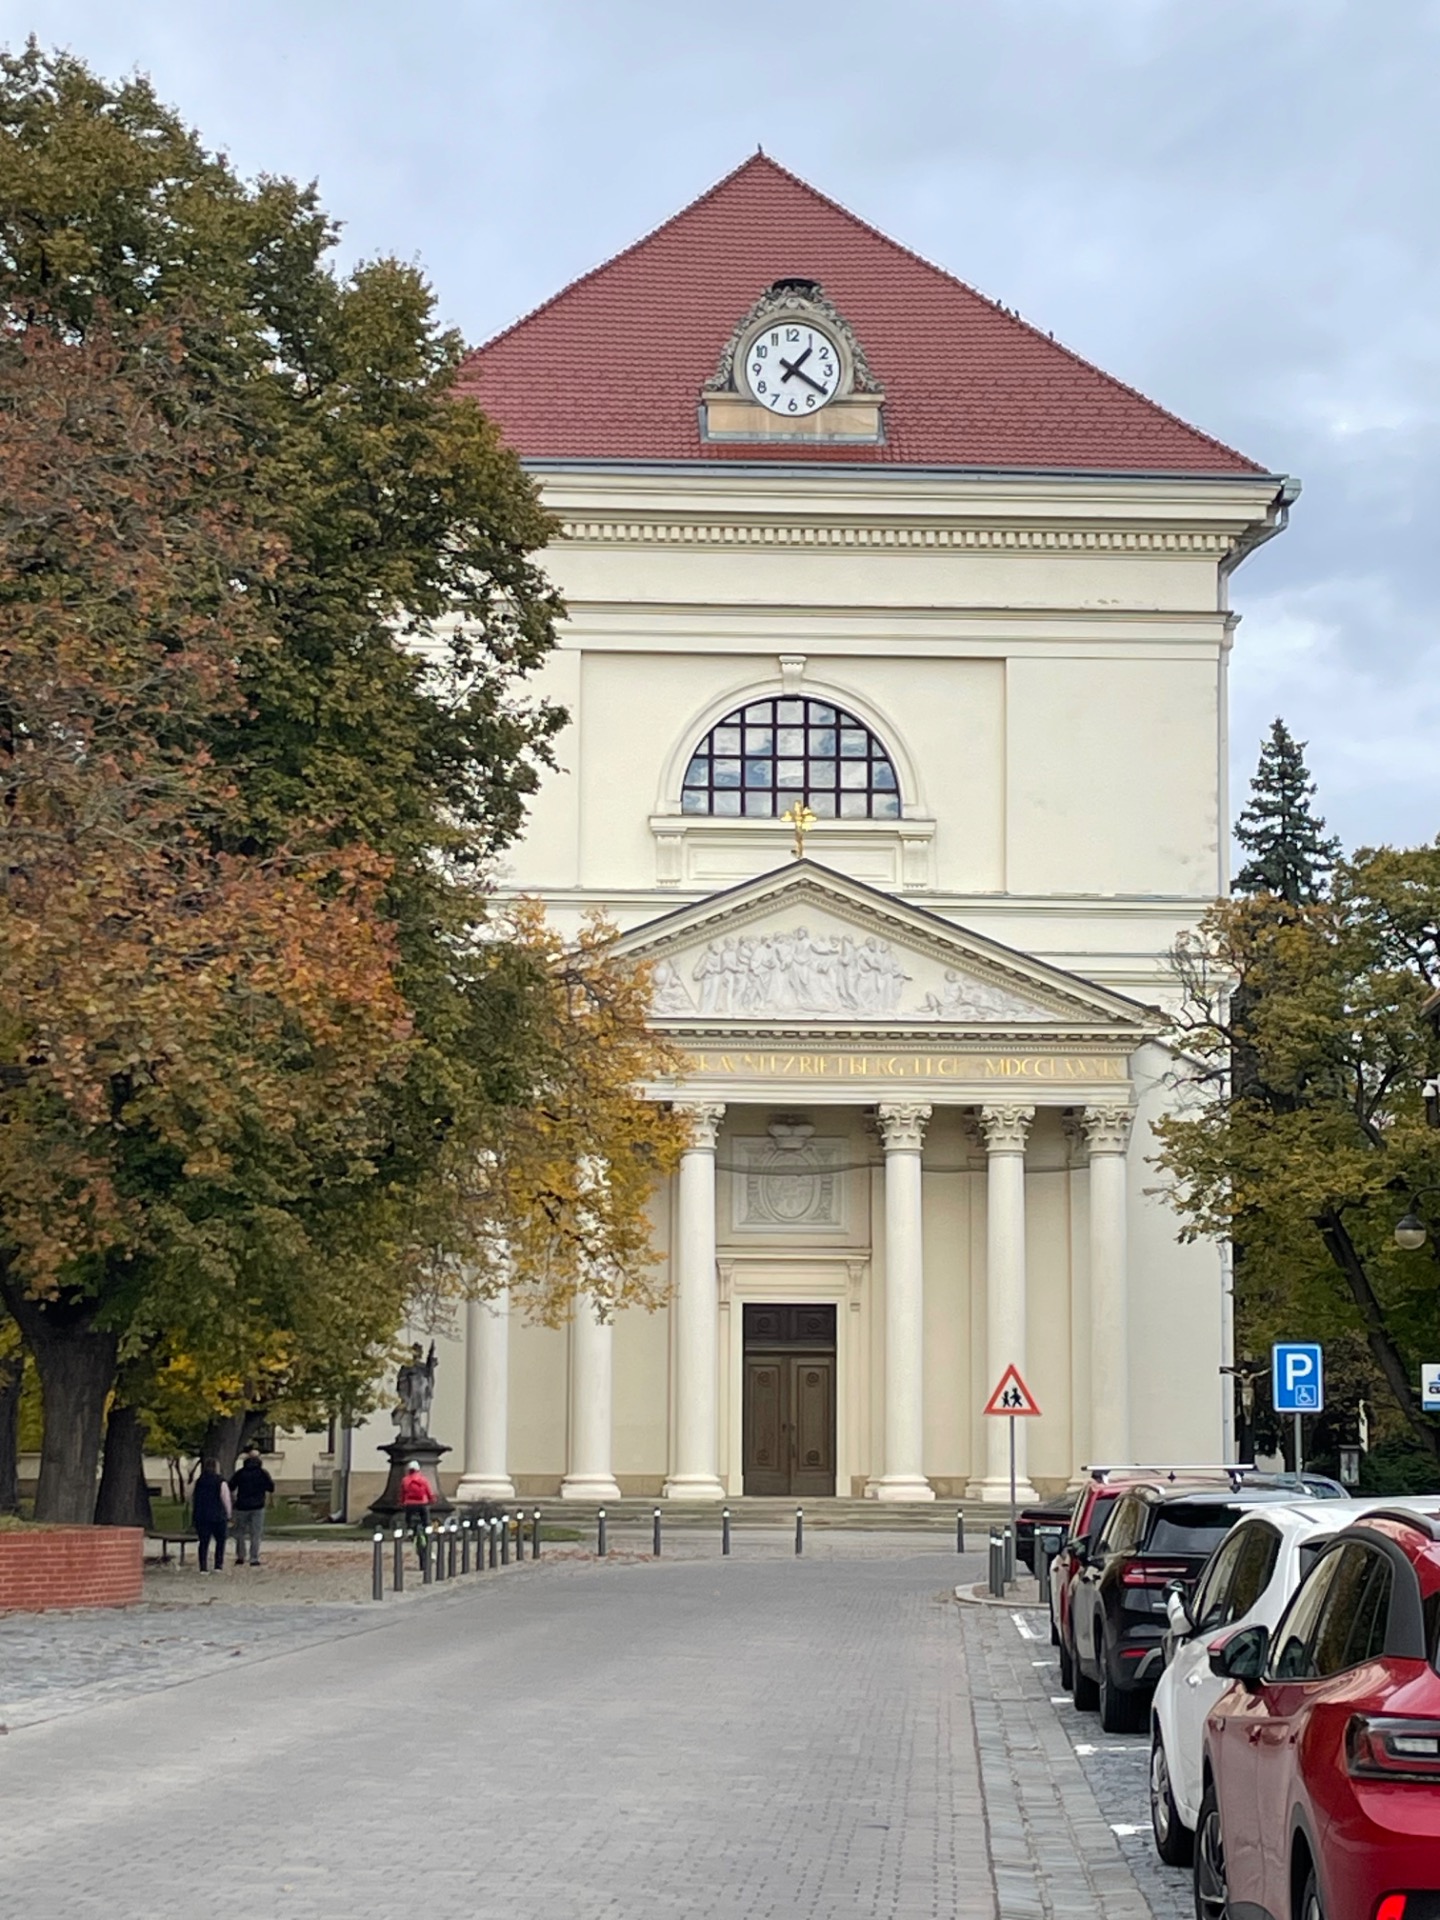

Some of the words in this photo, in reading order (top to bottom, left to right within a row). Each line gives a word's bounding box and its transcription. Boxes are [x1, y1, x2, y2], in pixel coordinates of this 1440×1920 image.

[771, 332, 779, 346] 11
[785, 328, 800, 342] 12
[756, 345, 768, 359] 10
[818, 346, 829, 360] 2
[752, 362, 762, 376] 9
[823, 364, 833, 377] 3
[757, 380, 767, 394] 8
[770, 393, 780, 407] 7
[787, 398, 798, 412] 6
[805, 394, 816, 408] 5
[1286, 1353, 1313, 1391] P
